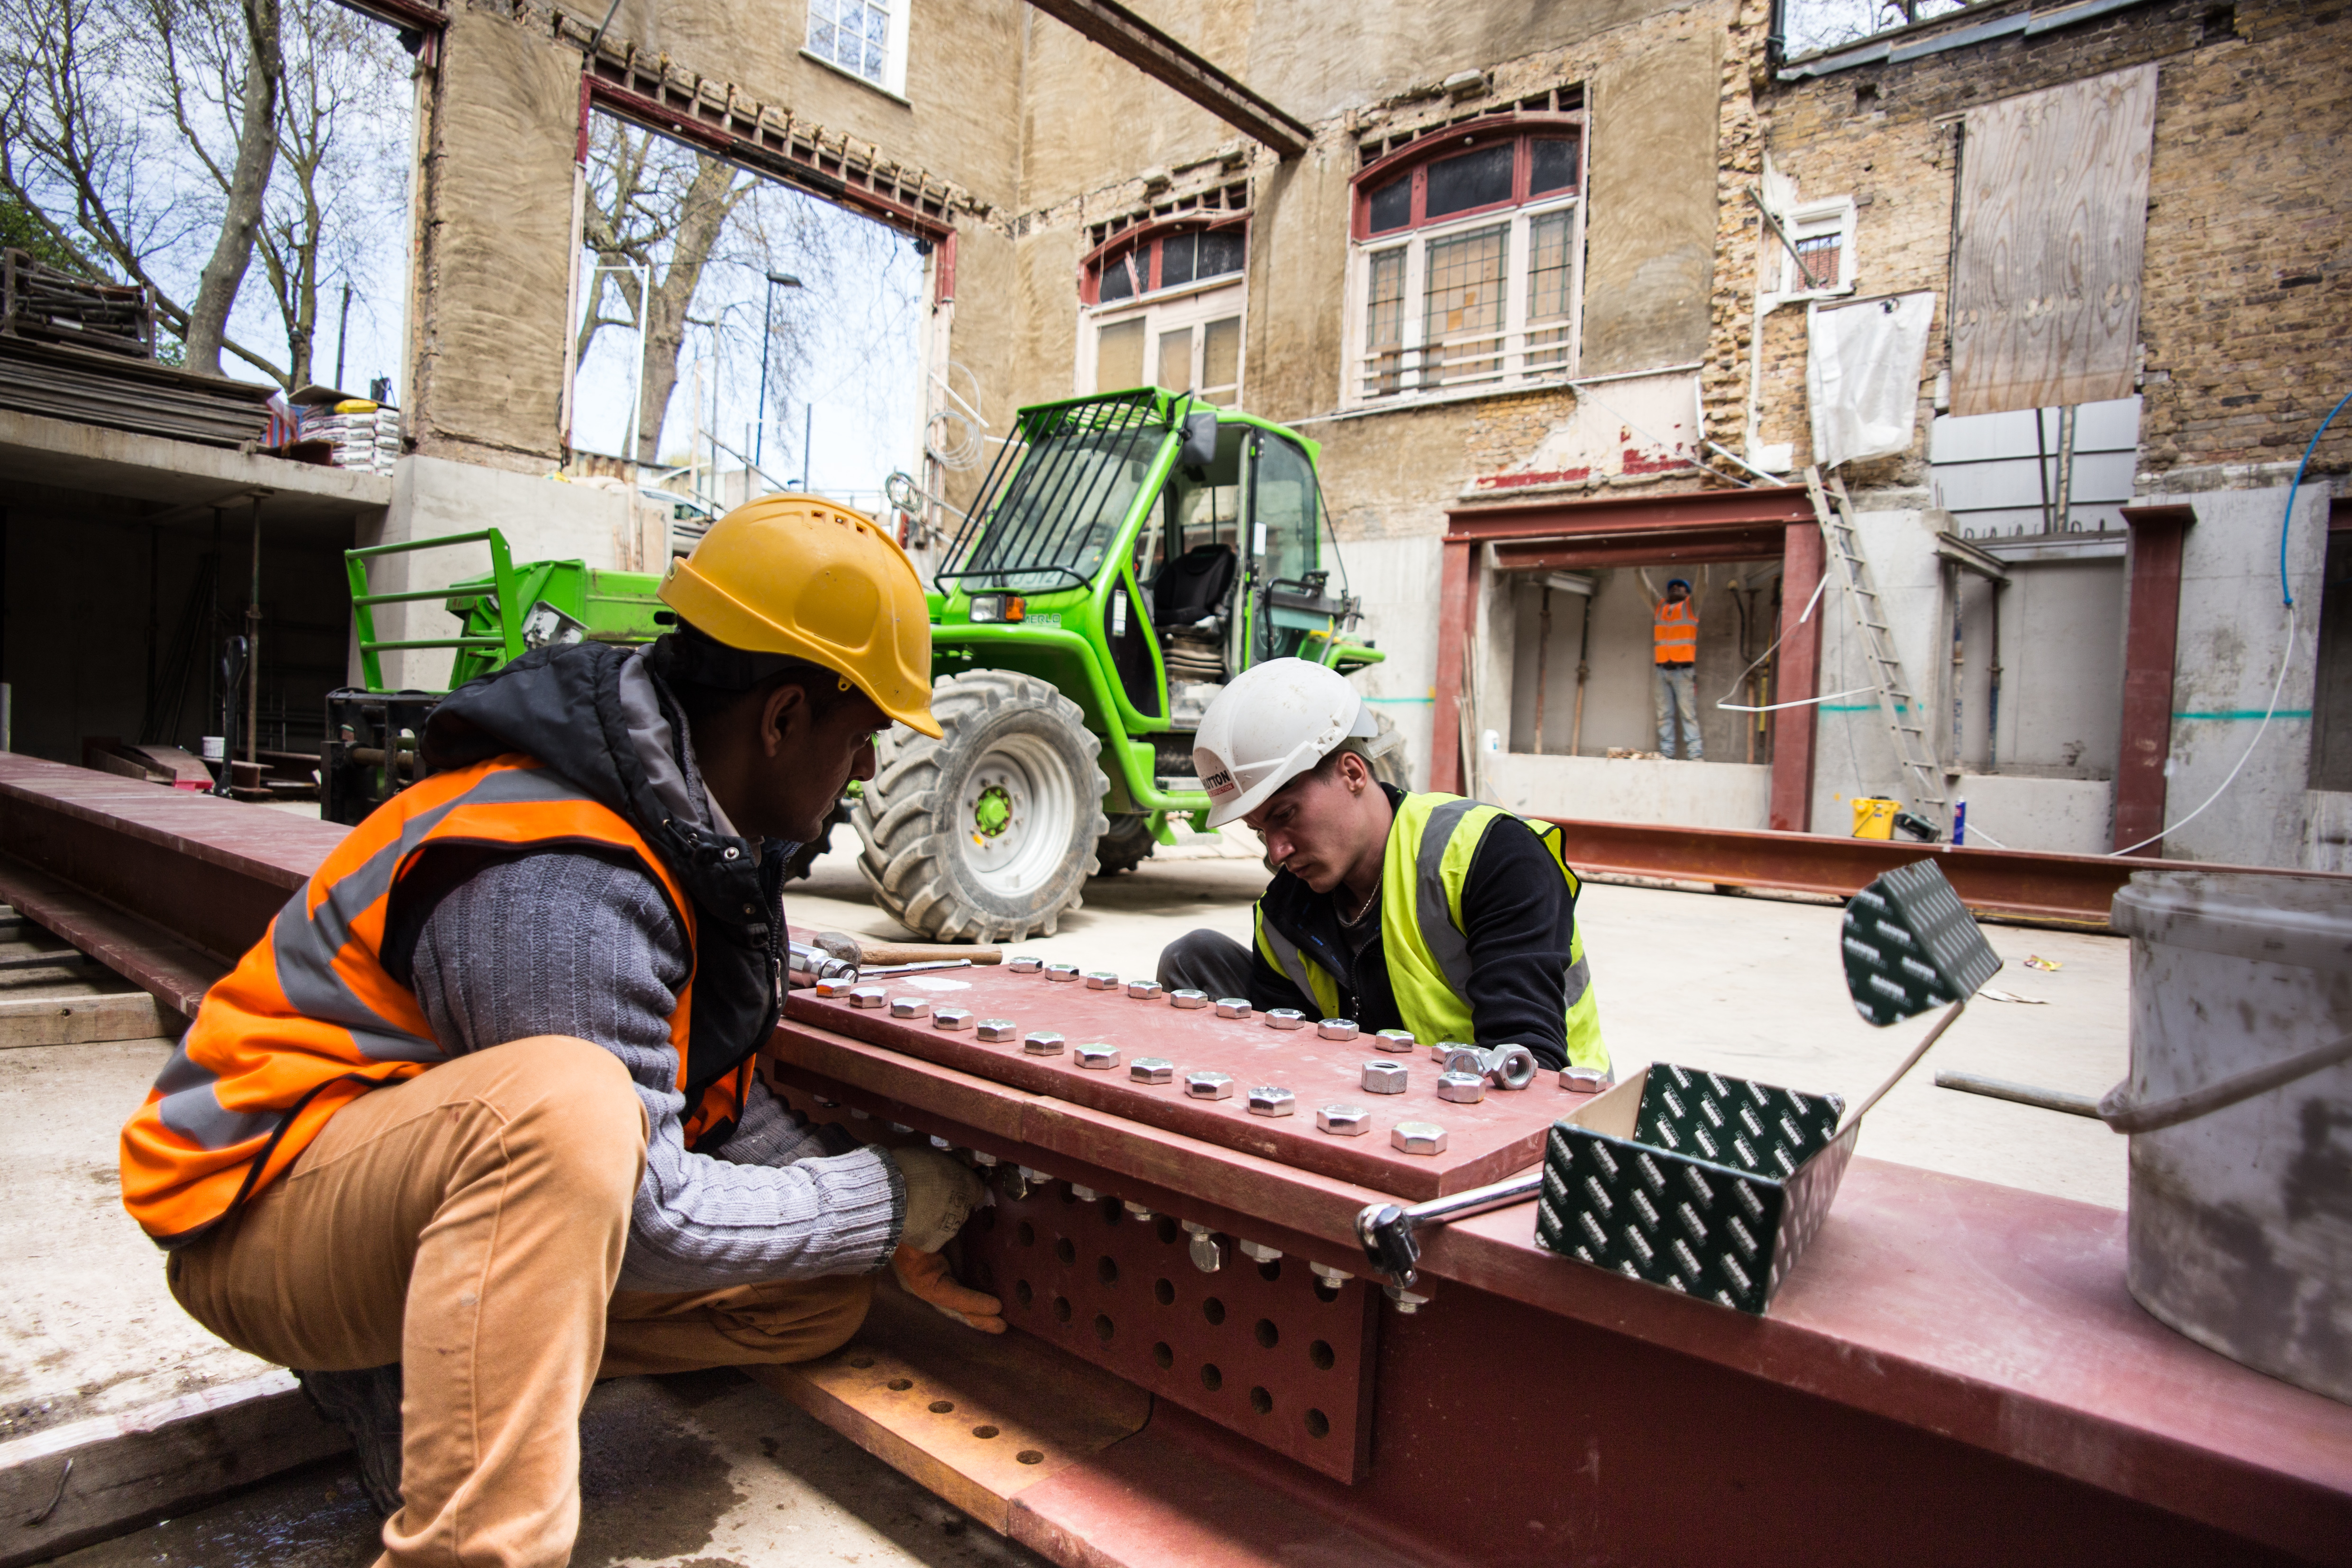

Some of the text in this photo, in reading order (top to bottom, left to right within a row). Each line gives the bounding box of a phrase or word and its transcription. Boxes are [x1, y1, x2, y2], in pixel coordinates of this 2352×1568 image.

[1663, 1091, 1684, 1118] MATE
[1664, 1082, 1687, 1112] METAL
[1702, 1091, 1725, 1122] METAL
[1658, 1111, 1681, 1143] METAL
[1701, 1100, 1722, 1127] MATE
[1740, 1108, 1761, 1136] MATE
[1741, 1100, 1765, 1132] METAL
[1781, 1109, 1806, 1142] METAL
[1656, 1120, 1677, 1148] MATE
[1694, 1129, 1716, 1157] MATE
[1696, 1121, 1720, 1153] METAL
[1735, 1130, 1759, 1162] METAL
[1780, 1117, 1802, 1146] MATE
[1734, 1138, 1755, 1167] MATE
[1774, 1148, 1795, 1175] MATE
[1775, 1139, 1799, 1168] META
[1540, 1198, 1564, 1230] MATE
